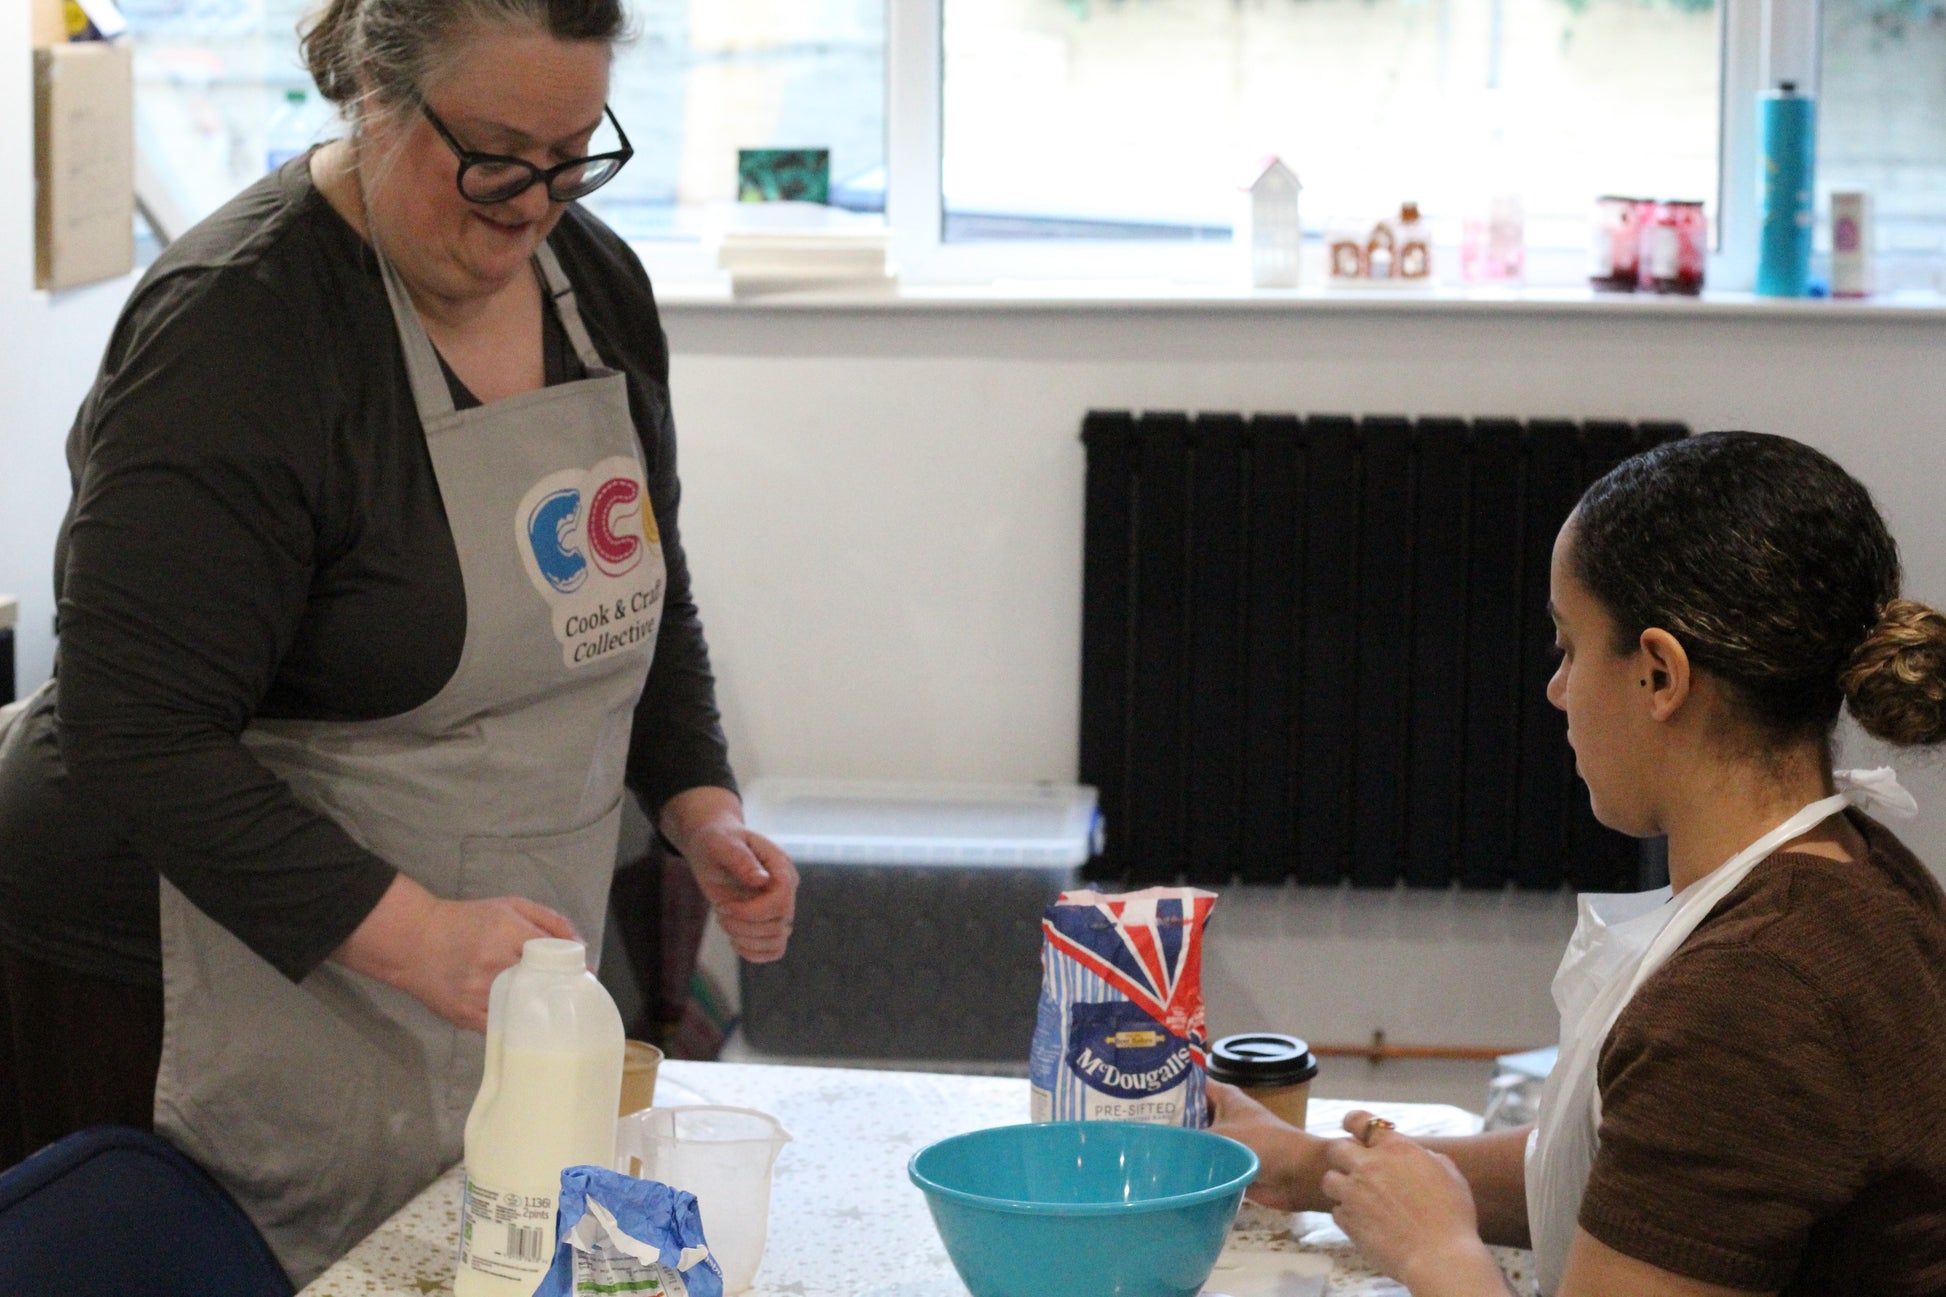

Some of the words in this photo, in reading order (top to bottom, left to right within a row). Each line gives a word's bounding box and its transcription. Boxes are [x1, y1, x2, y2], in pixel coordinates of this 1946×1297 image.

[566, 604, 609, 637] Cook
[614, 598, 625, 620] &
[631, 579, 661, 613] Craf
[574, 618, 655, 662] Collective
[1076, 1047, 1190, 1091] McDougalls
[1095, 1102, 1176, 1117] PRE-SIFTED
